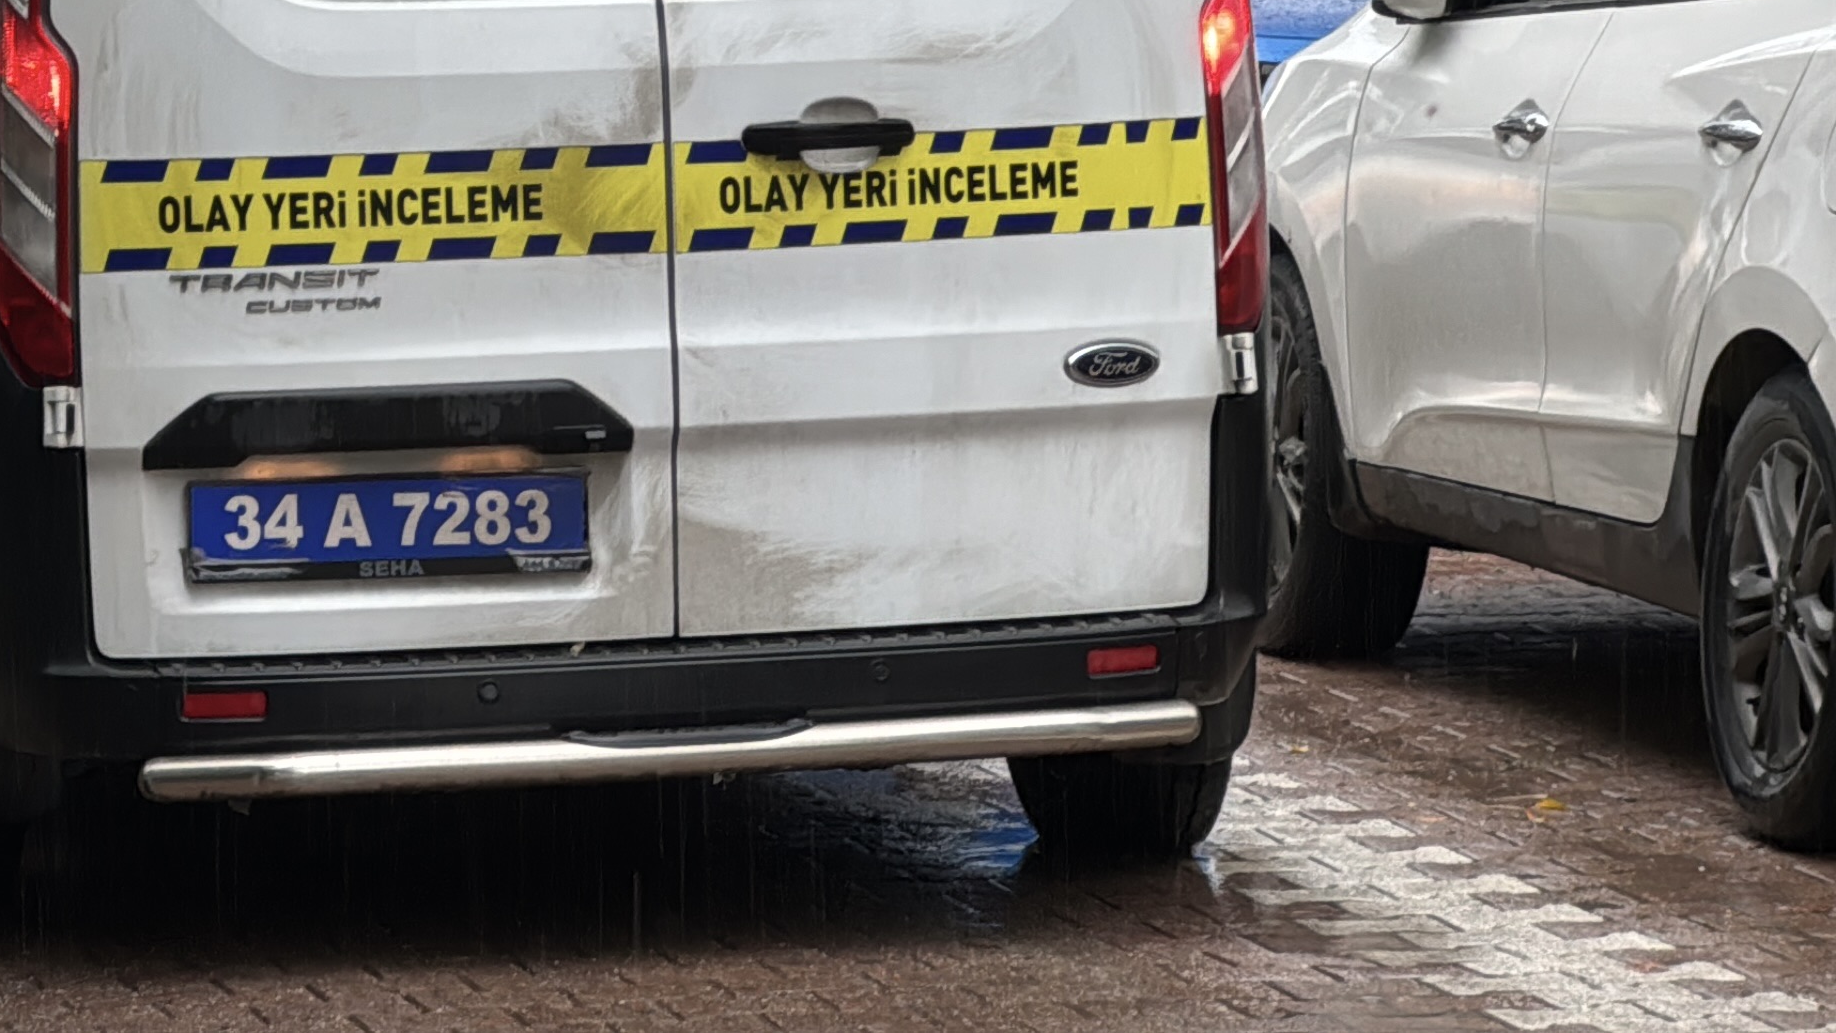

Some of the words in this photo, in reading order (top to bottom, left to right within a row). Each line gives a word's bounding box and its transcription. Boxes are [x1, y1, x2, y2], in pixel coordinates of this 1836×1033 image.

[719, 173, 810, 215] OLAY
[158, 193, 253, 234] OLAY
[169, 268, 380, 293] TRANSIT
[246, 296, 382, 314] CUSTOM
[1088, 351, 1142, 377] Ford
[223, 493, 304, 550] 34
[323, 493, 372, 548] A
[392, 489, 552, 546] 7283
[358, 559, 425, 578] SEHA
